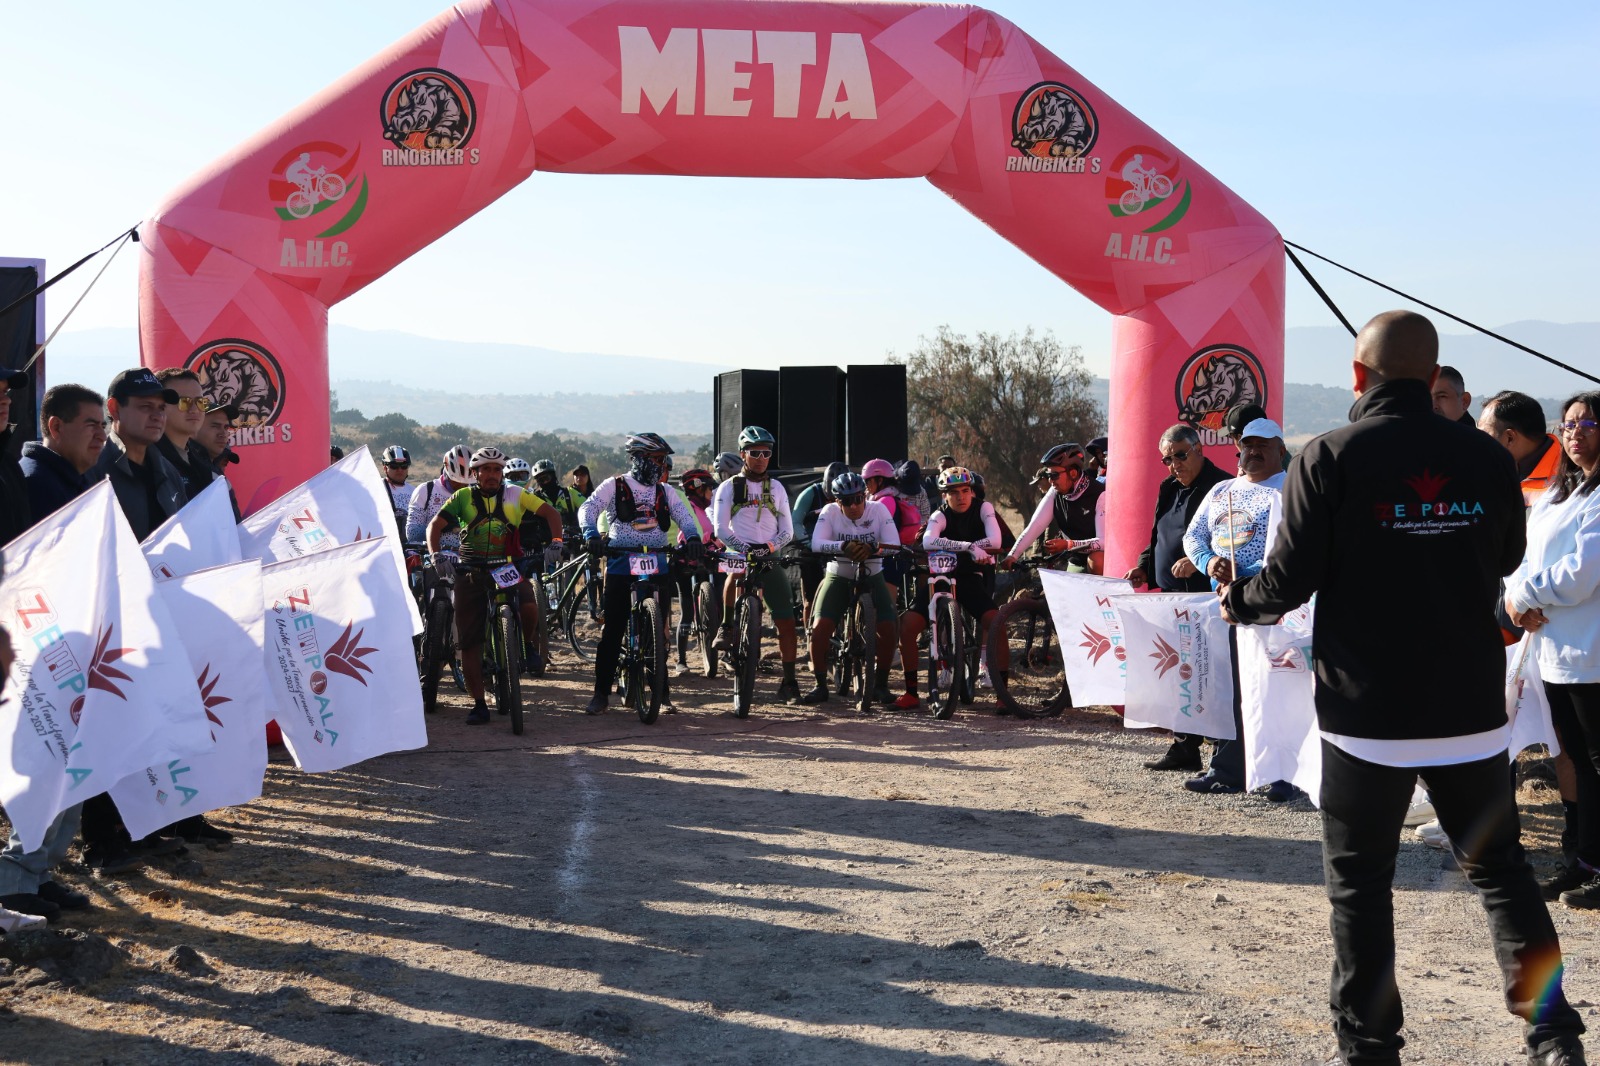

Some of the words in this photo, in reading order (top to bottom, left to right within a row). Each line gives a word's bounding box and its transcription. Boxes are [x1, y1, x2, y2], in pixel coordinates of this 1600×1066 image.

[618, 26, 878, 120] META
[280, 238, 353, 268] A.H.C.
[1104, 232, 1176, 265] A.H.C.
[500, 569, 519, 584] 003
[640, 558, 655, 571] 011
[727, 558, 745, 569] 025
[938, 557, 957, 569] 022
[275, 618, 291, 647] Unidos
[277, 654, 296, 694] 2024-2027
[18, 691, 48, 737] 2024-2027
